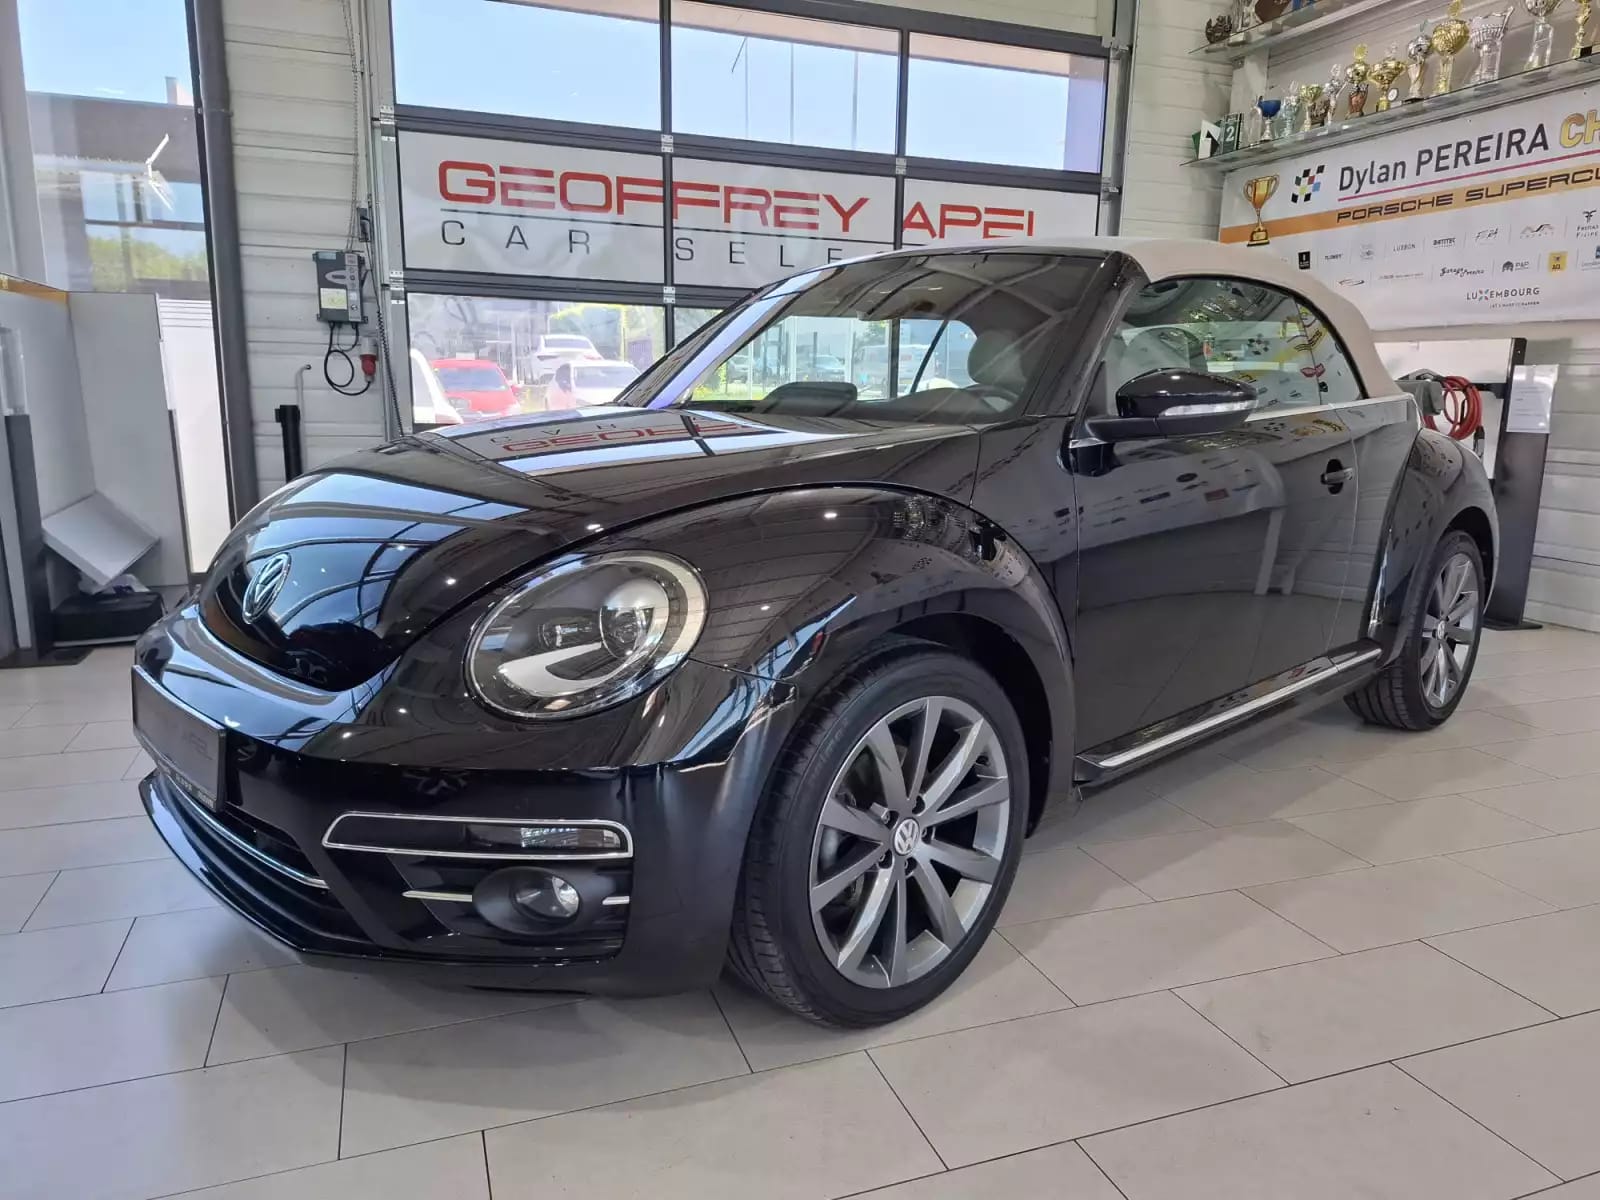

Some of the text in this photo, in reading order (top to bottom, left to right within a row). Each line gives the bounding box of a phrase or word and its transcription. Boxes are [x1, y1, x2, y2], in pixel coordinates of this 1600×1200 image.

[1338, 159, 1406, 194] Dylan
[1415, 122, 1549, 177] PEREIRA
[438, 160, 870, 233] GEOFFREY
[1336, 167, 1600, 223] PORSCHE SUPERC
[441, 219, 590, 255] CAR
[1466, 287, 1540, 302] LUXEMBOURG
